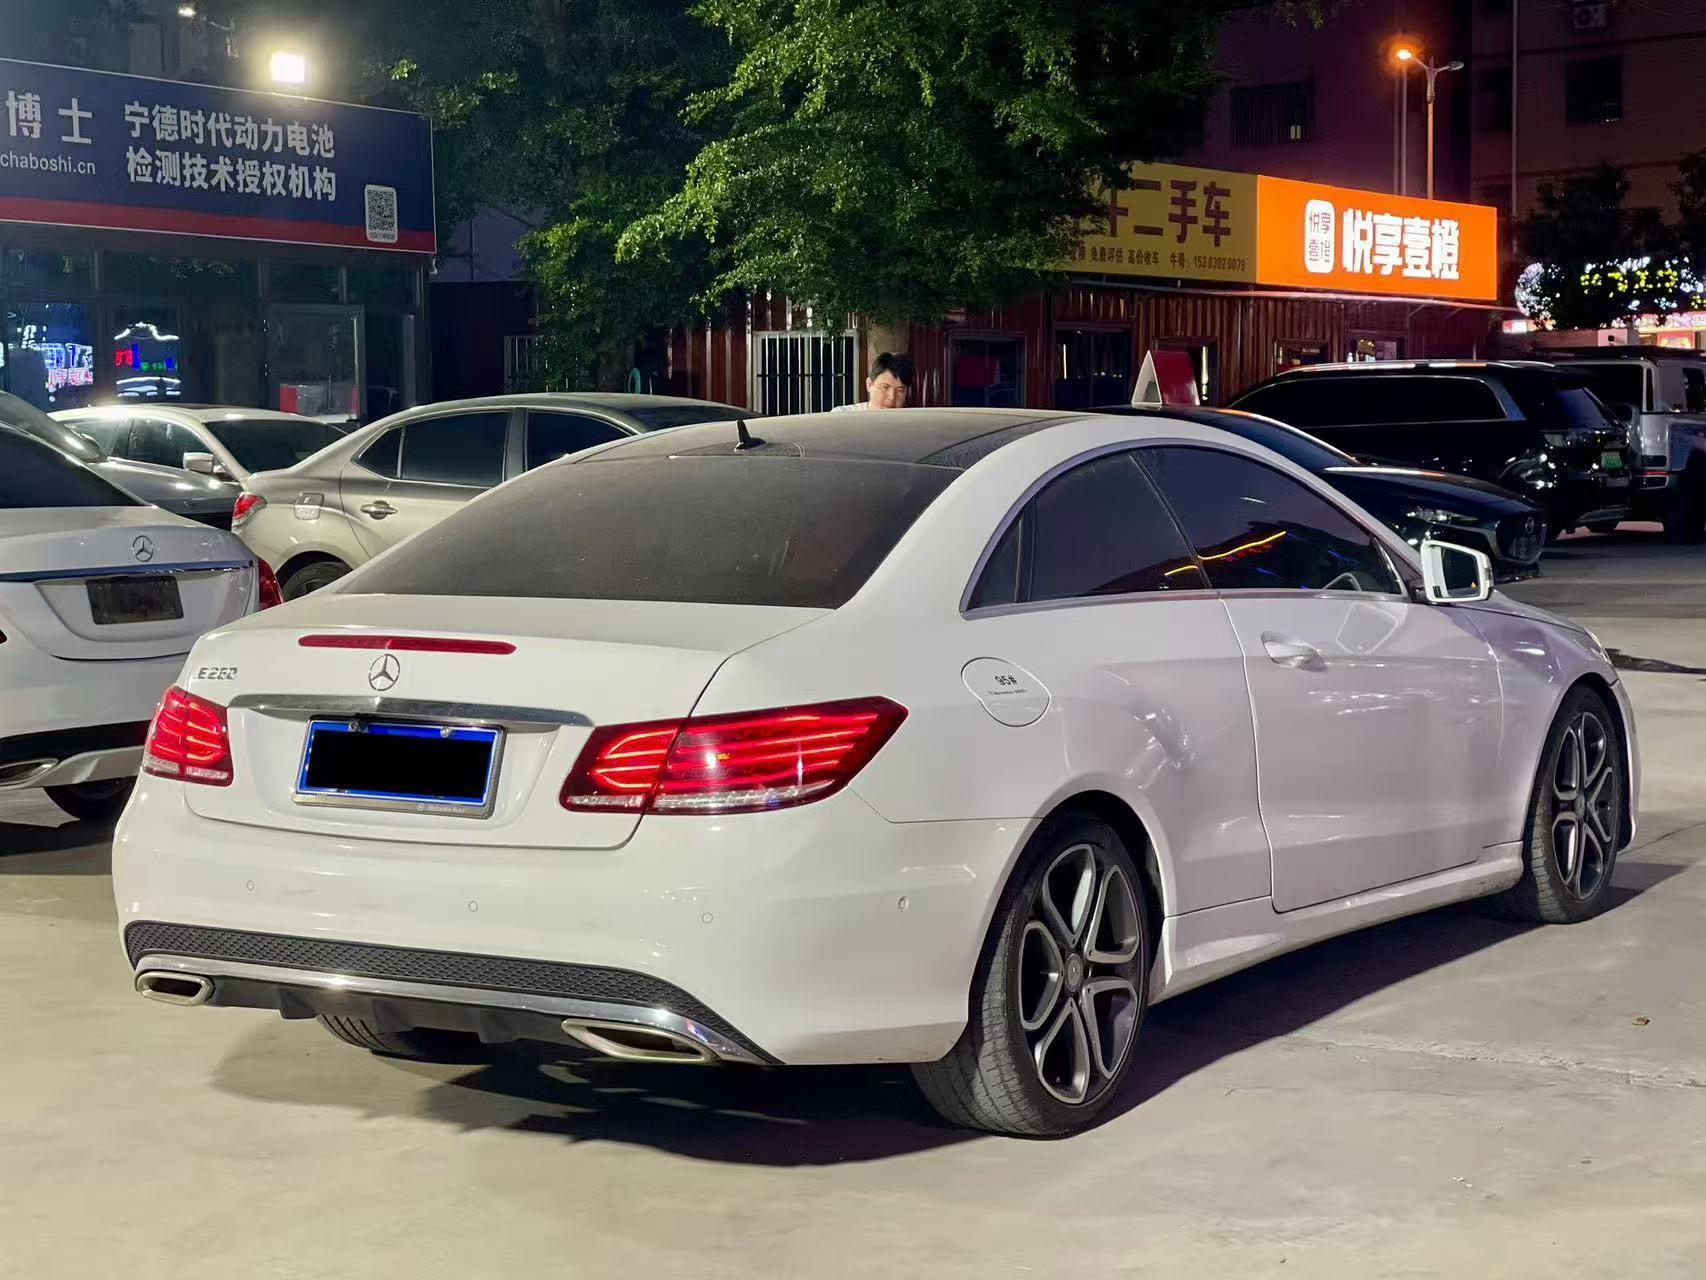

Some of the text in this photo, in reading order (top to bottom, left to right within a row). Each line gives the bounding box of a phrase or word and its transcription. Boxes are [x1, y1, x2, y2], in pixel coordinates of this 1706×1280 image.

[124, 101, 335, 158] 宁德时代动力电池
[0, 150, 96, 174] chaboshi.cn
[126, 145, 337, 201] 检测技术授权机构
[1342, 208, 1460, 279] 悦享壹橙
